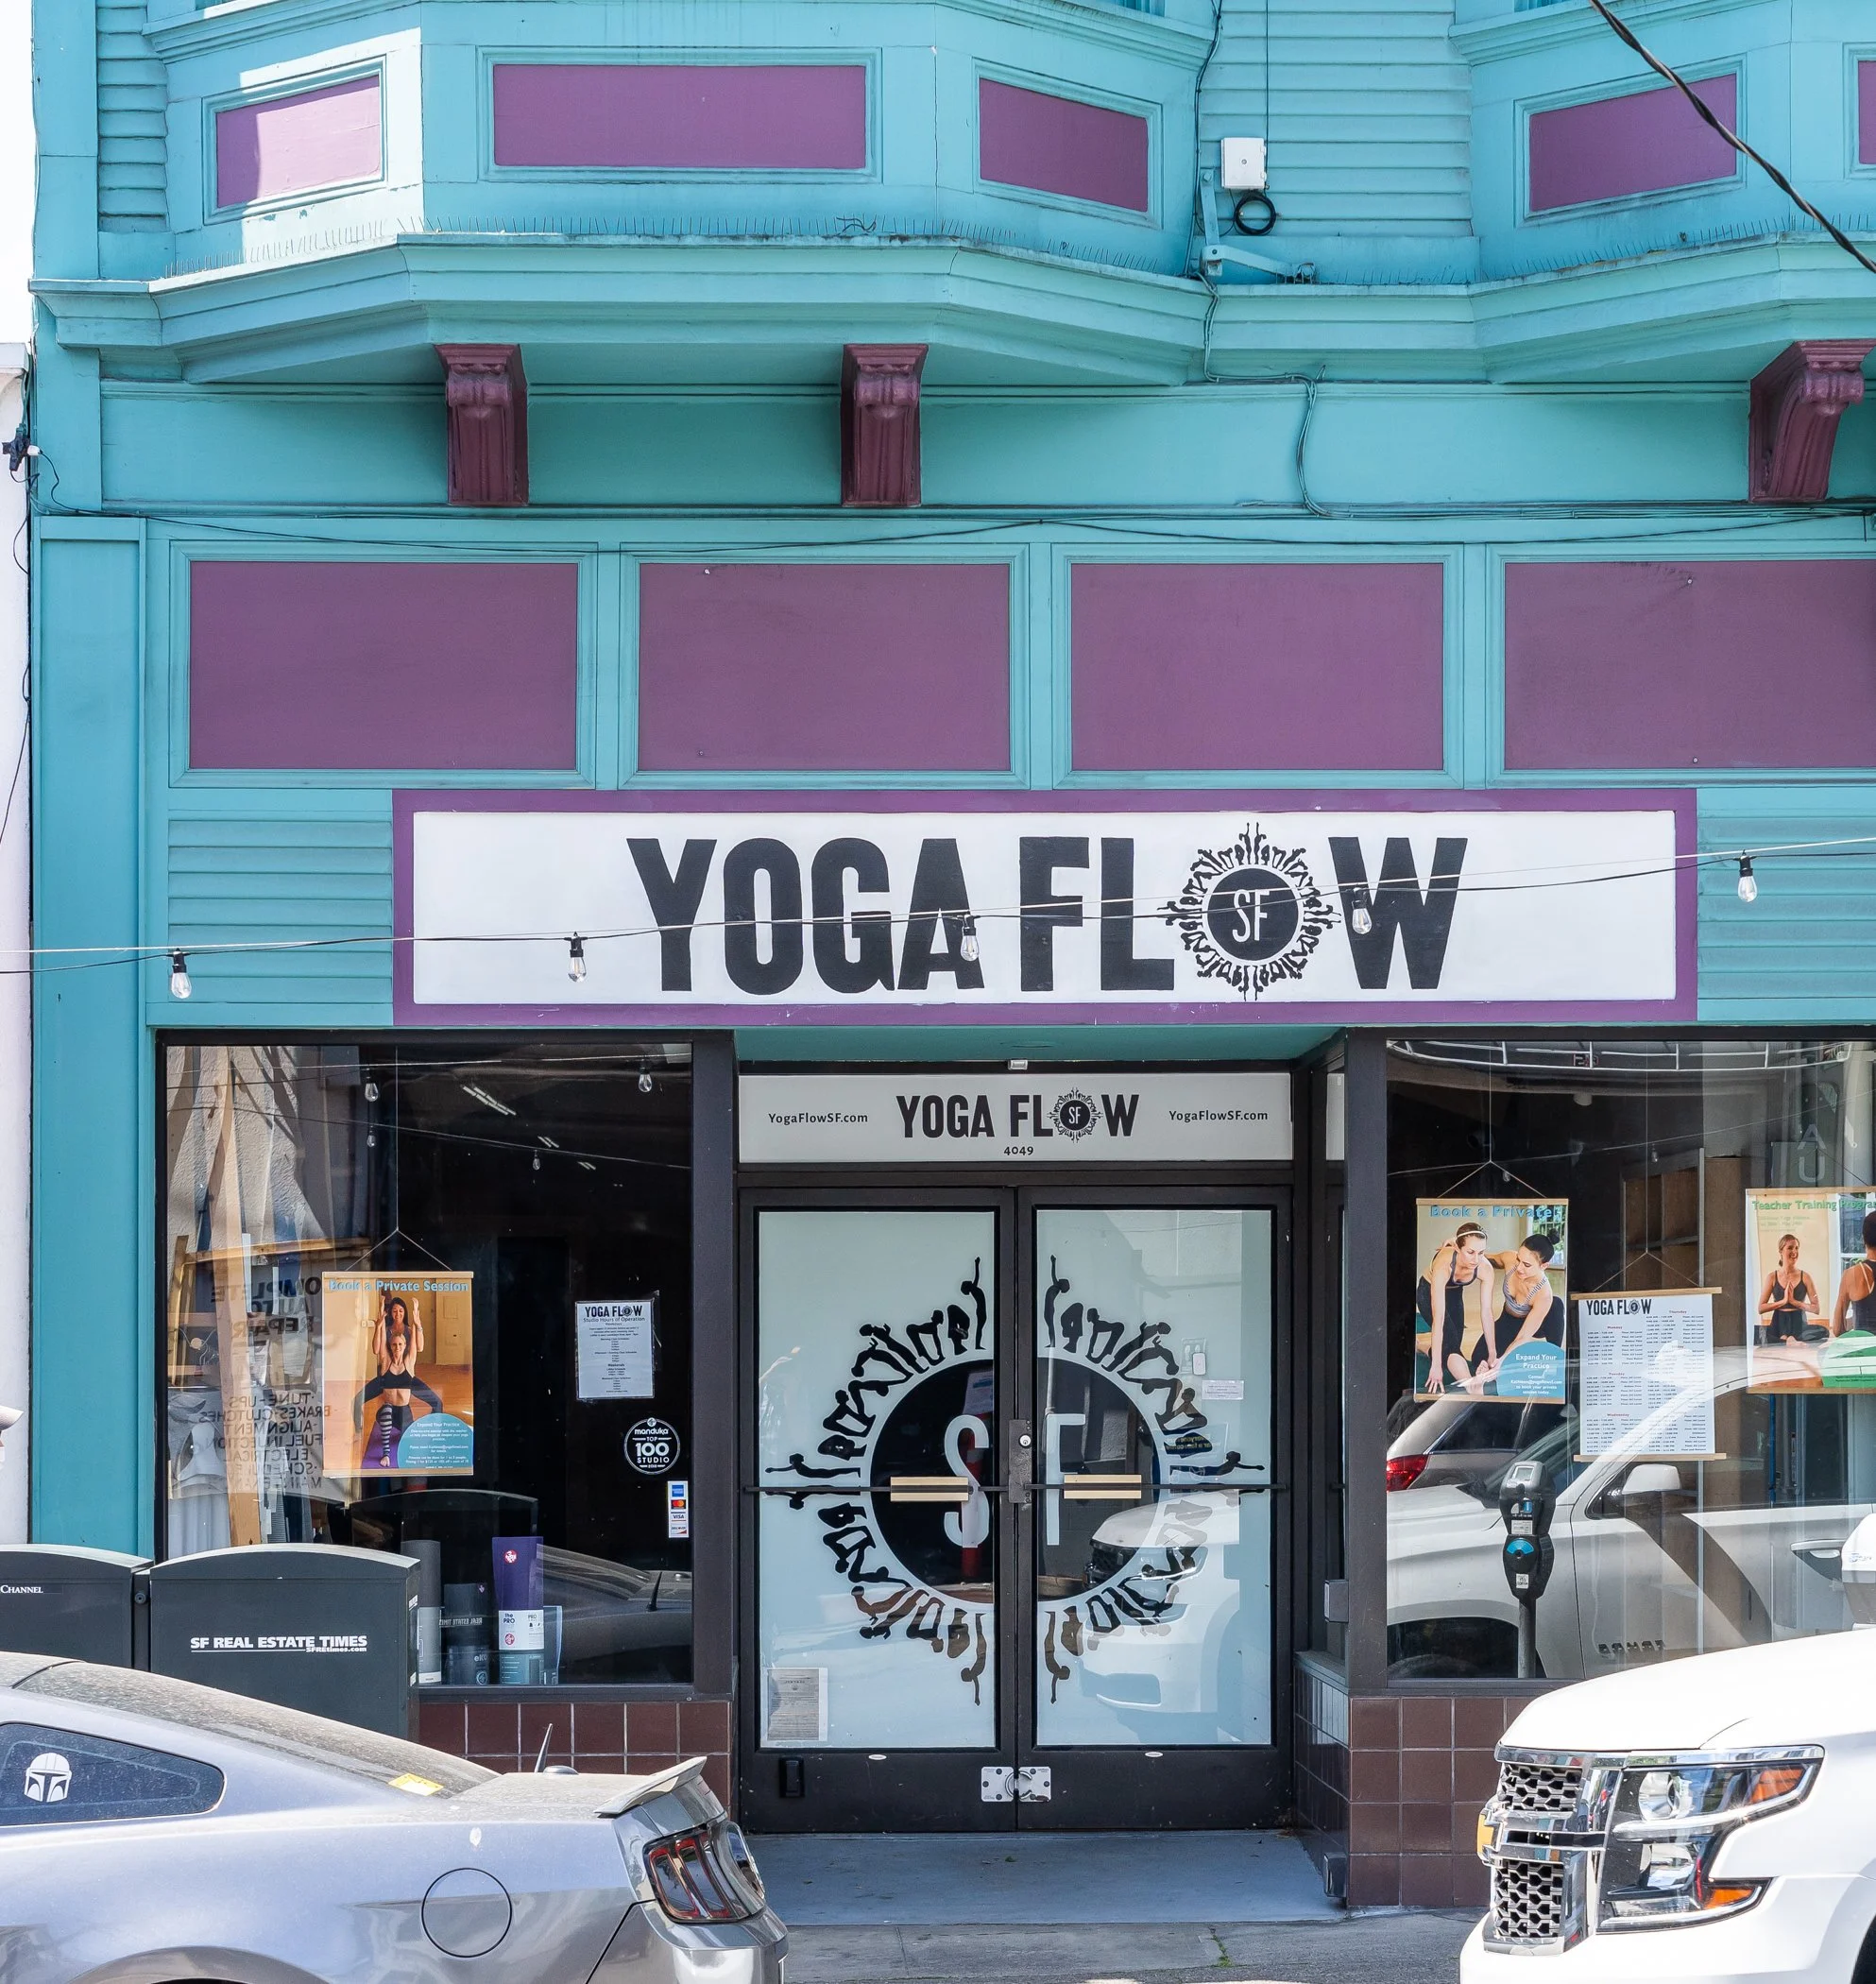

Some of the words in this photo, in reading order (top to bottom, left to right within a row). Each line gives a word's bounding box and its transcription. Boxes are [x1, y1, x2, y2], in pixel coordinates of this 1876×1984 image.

[626, 837, 984, 996] YOGA
[767, 1111, 869, 1126] YogaFlowSF.com
[895, 1094, 996, 1139] YOGA
[1168, 1108, 1270, 1123] YogaFlowSF.com
[1003, 1146, 1035, 1156] 4049
[1430, 1205, 1472, 1218] Book
[1478, 1208, 1487, 1218] a
[1492, 1205, 1553, 1218] Private
[1751, 1200, 1793, 1210] Teacher
[1795, 1199, 1837, 1212] Training
[1839, 1199, 1876, 1211] Progra
[330, 1278, 362, 1291] Book
[365, 1282, 372, 1291] a
[376, 1278, 420, 1291] Private
[423, 1278, 469, 1291] Session
[585, 1306, 610, 1318] YOGA
[1586, 1299, 1614, 1315] YOGA
[1515, 1353, 1540, 1361] Expand
[634, 1428, 670, 1437] manduka
[635, 1442, 670, 1457] 100
[190, 1636, 210, 1649] SF
[213, 1635, 254, 1649] REAL
[258, 1635, 316, 1649] ESTATE
[319, 1634, 368, 1648] TIMES
